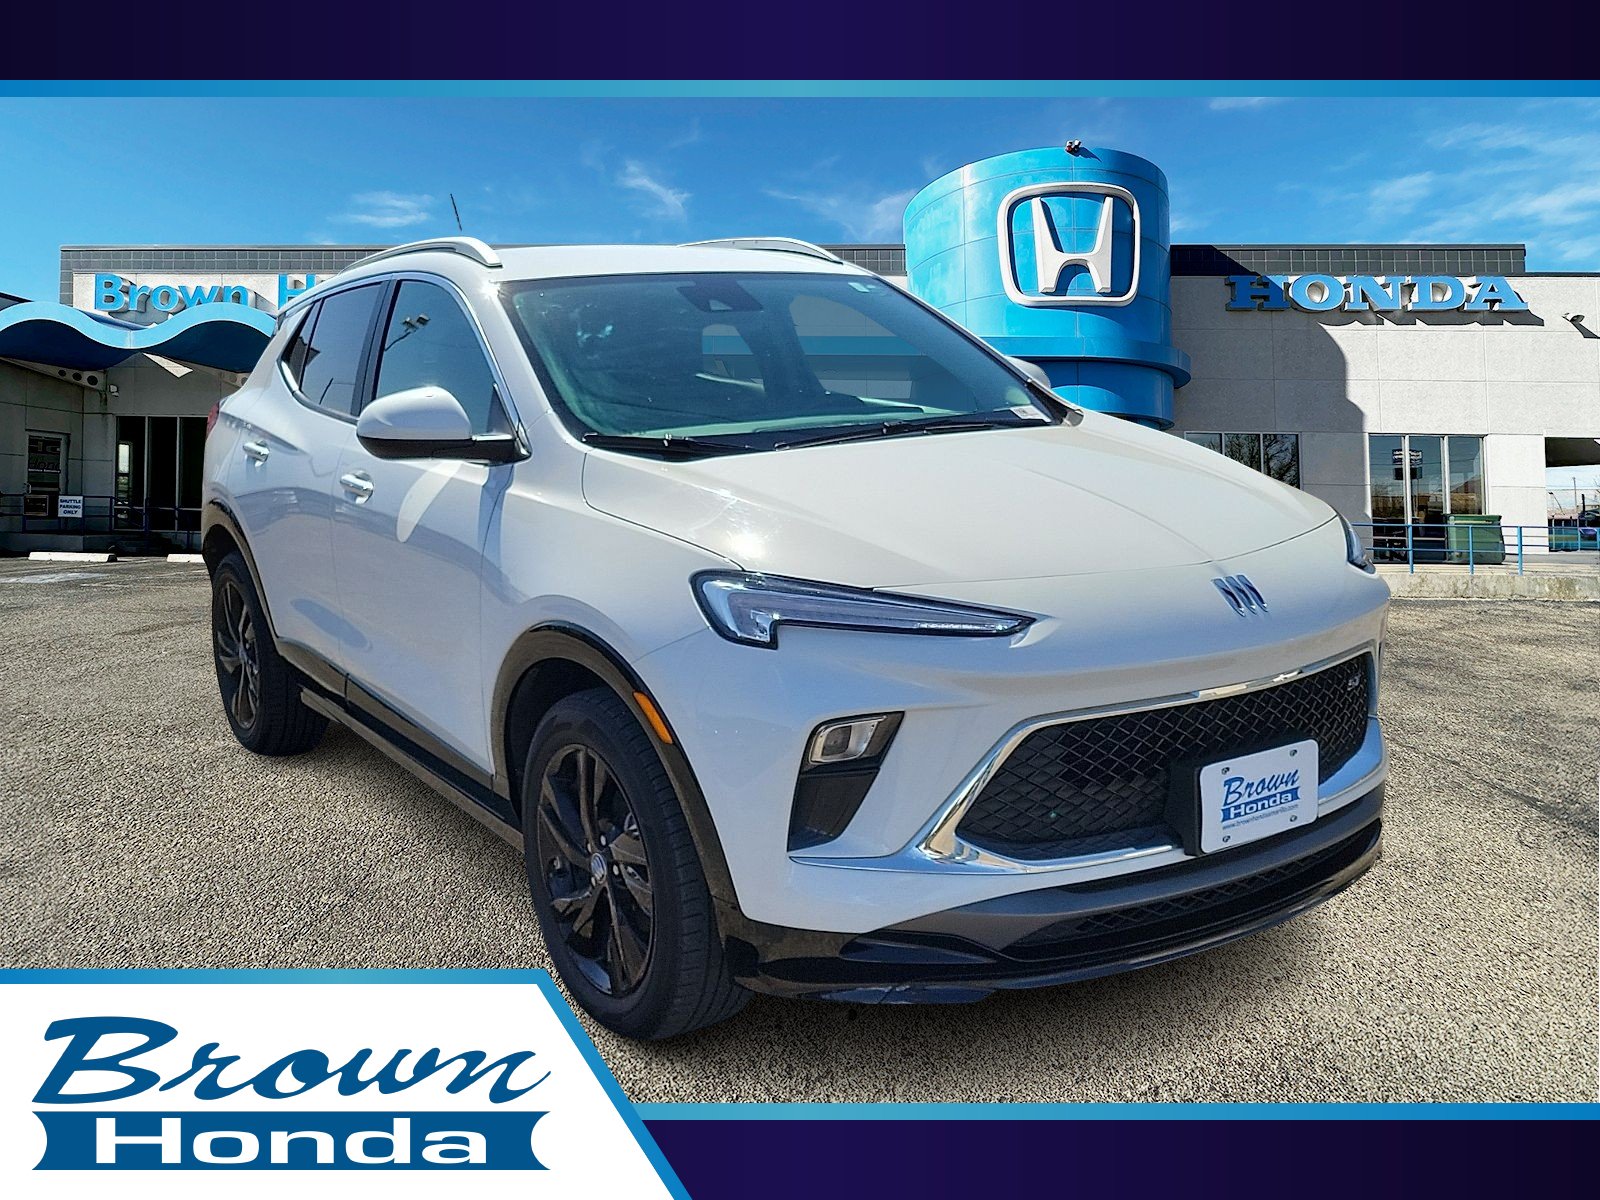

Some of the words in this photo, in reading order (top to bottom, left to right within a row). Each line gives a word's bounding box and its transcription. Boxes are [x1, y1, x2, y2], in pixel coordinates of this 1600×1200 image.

[94, 273, 250, 312] Brown
[1225, 273, 1529, 312] HONDA
[1223, 769, 1300, 807] Brown
[1229, 793, 1293, 819] Honda
